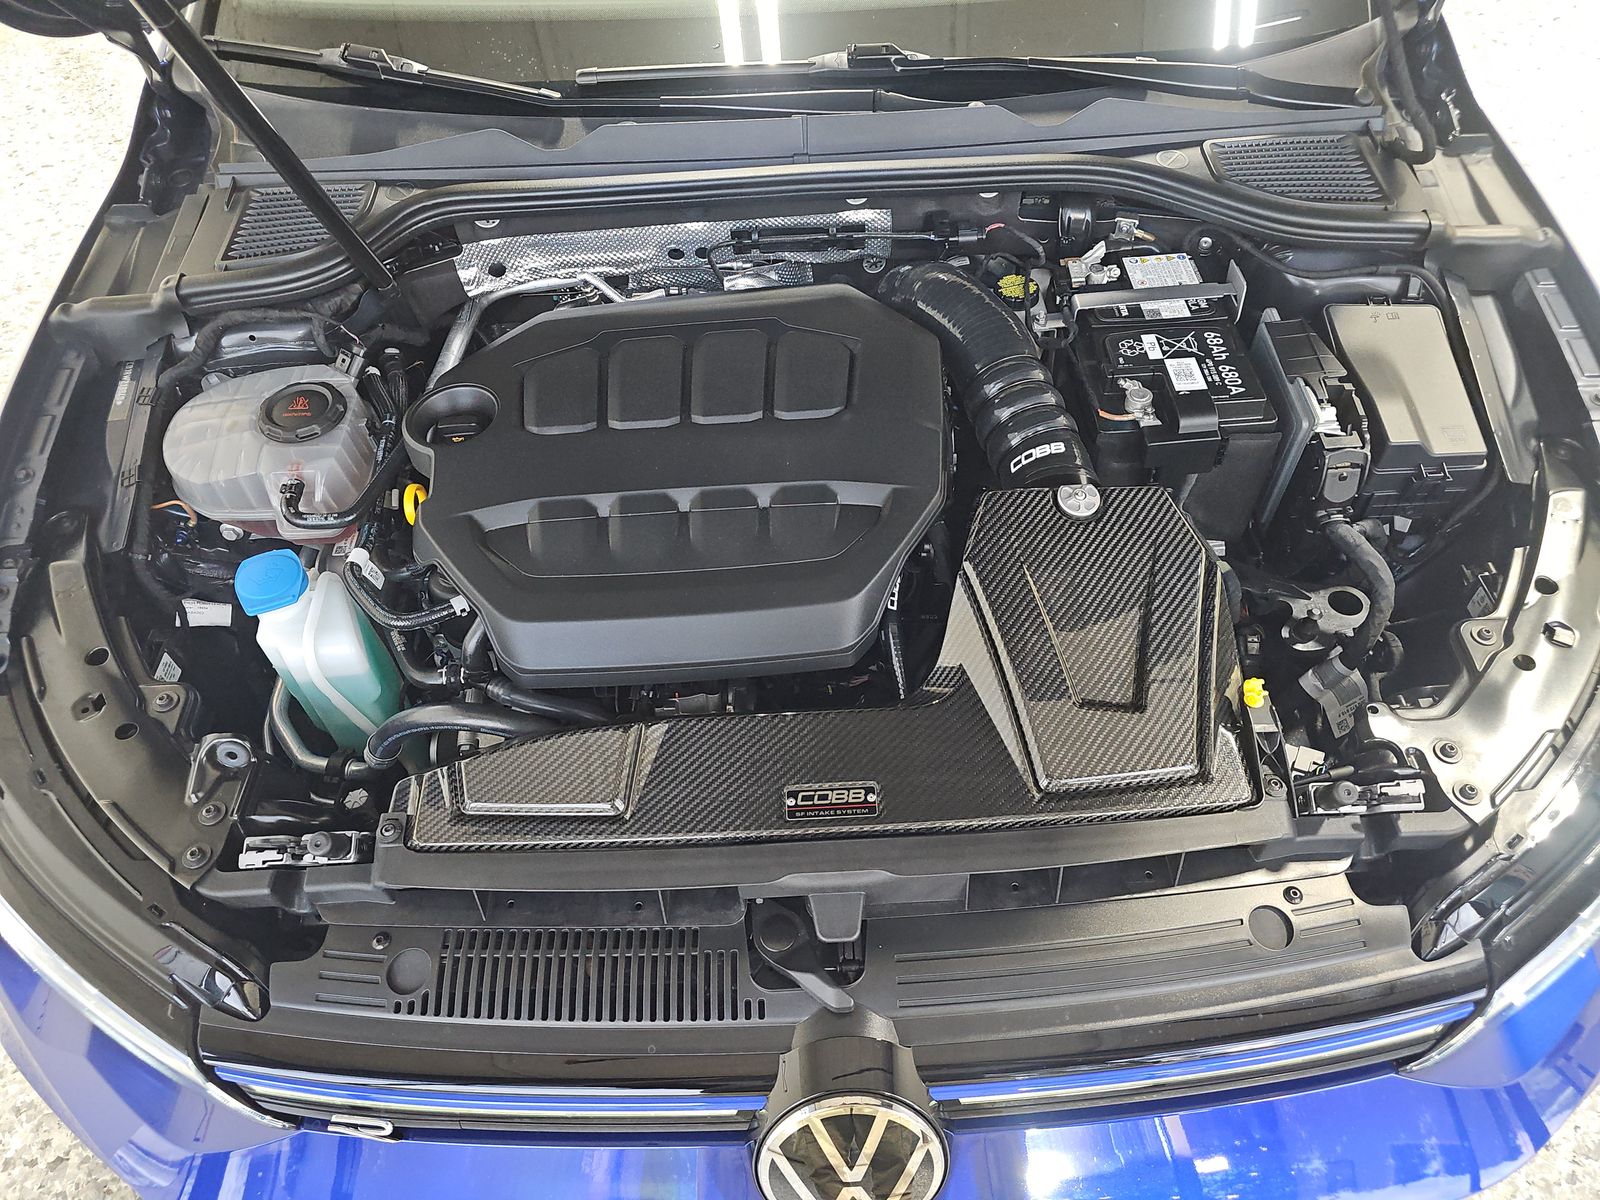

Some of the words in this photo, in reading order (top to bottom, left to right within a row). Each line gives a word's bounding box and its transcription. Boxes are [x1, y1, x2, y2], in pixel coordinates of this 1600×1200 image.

[1147, 342, 1156, 352] Pb
[1203, 332, 1230, 361] 68Ah
[1218, 365, 1247, 395] 680A
[1010, 441, 1066, 474] COBB
[797, 788, 866, 806] COBB
